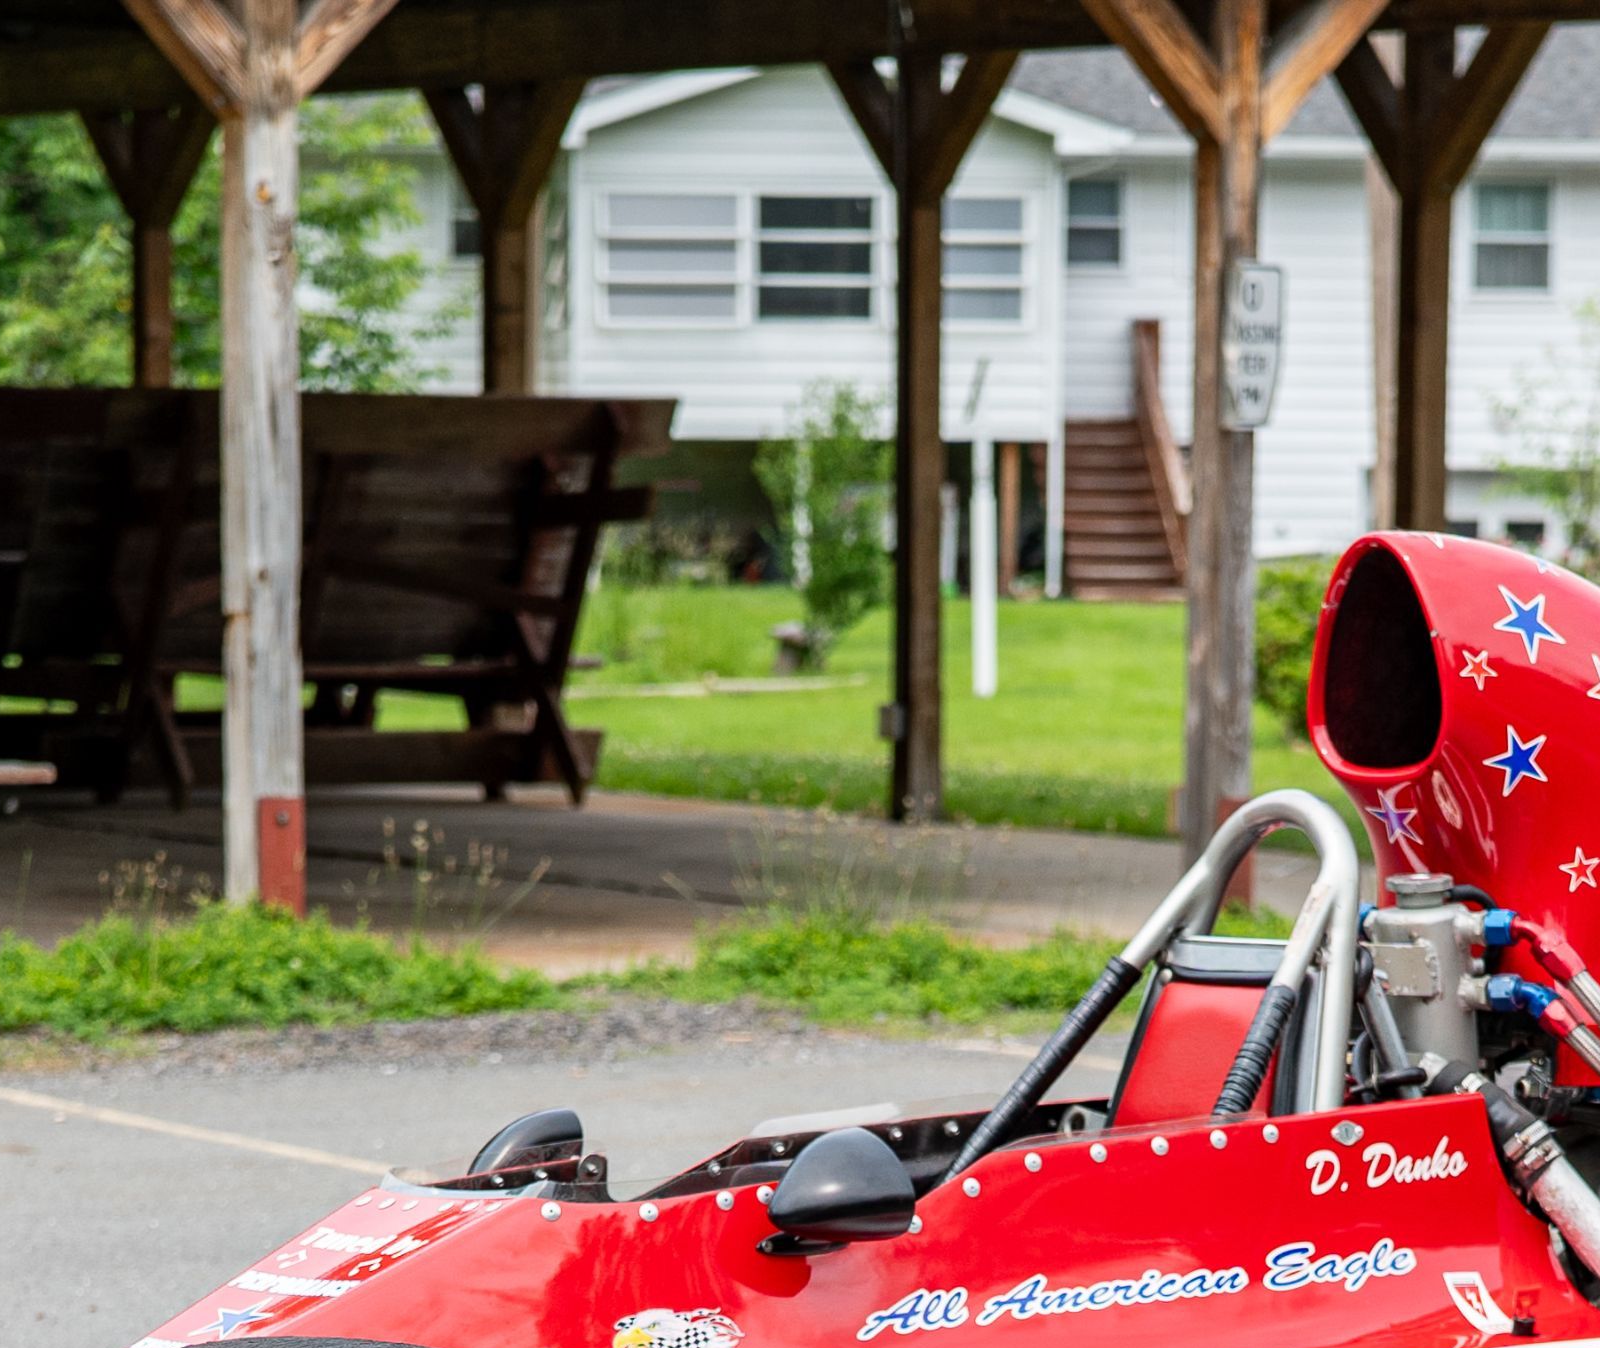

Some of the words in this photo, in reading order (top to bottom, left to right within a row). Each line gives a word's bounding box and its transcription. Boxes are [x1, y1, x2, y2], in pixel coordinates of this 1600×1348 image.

[1306, 1149, 1348, 1196] D.
[1362, 1136, 1468, 1188] Danko
[857, 1287, 967, 1340] All
[977, 1267, 1248, 1327] American
[1266, 1239, 1416, 1291] Eagle
